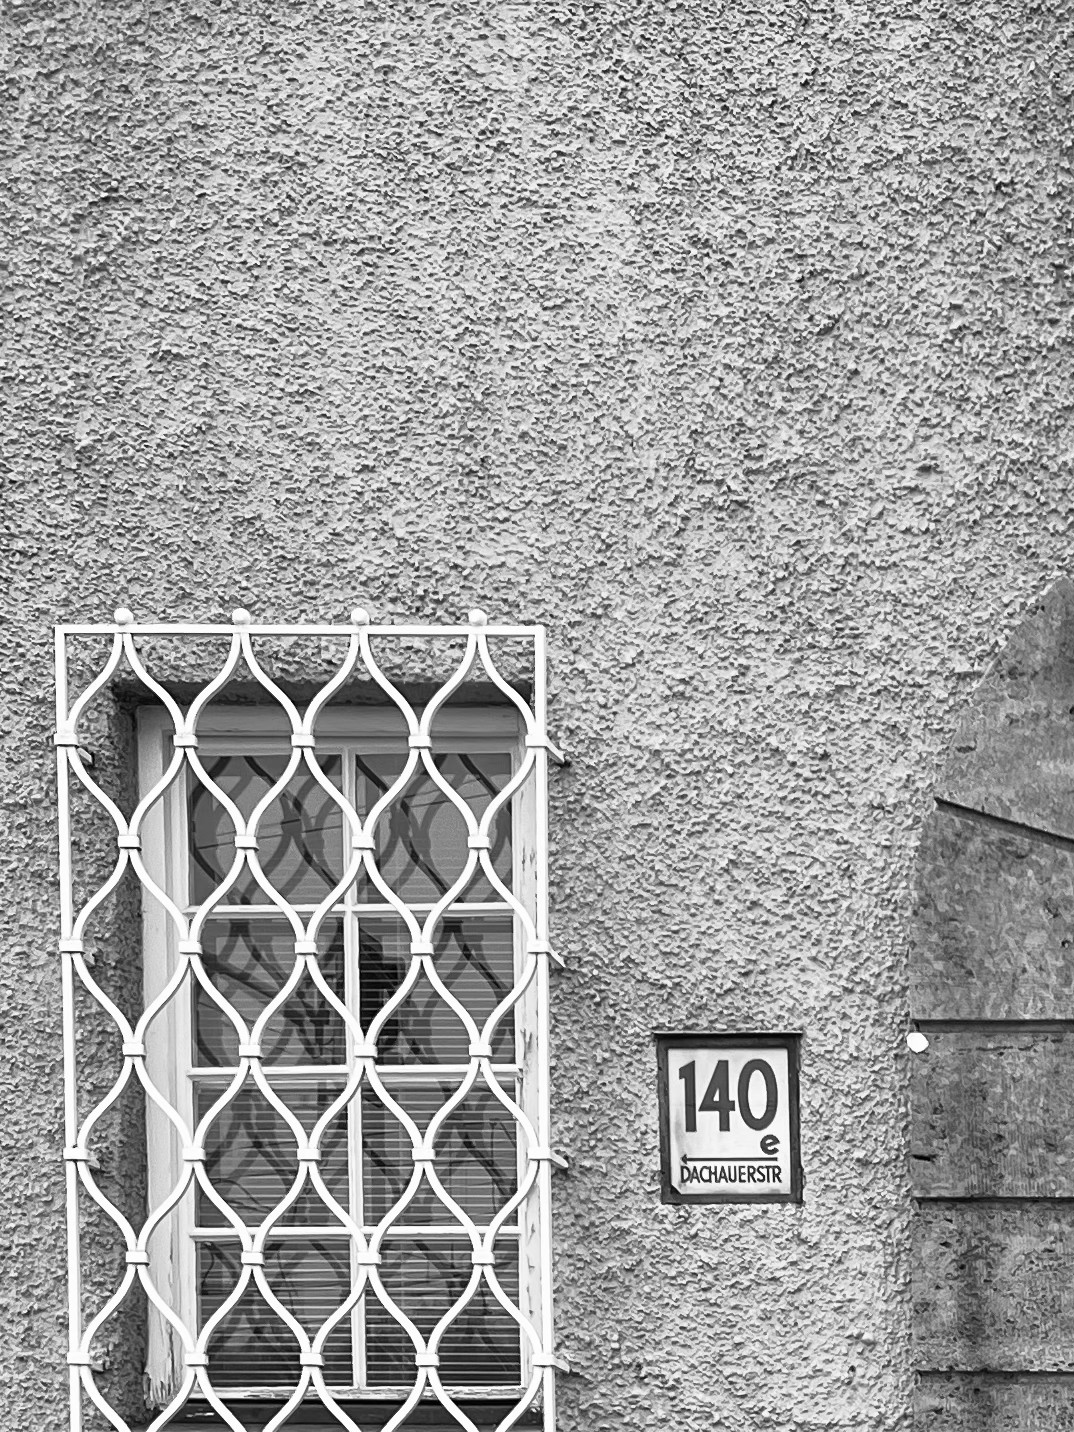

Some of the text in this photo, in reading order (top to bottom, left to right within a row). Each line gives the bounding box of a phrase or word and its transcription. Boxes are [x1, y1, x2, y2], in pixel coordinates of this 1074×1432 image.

[678, 1058, 779, 1133] 140
[759, 1133, 781, 1156] e
[680, 1164, 783, 1184] DACHAUERSTR
